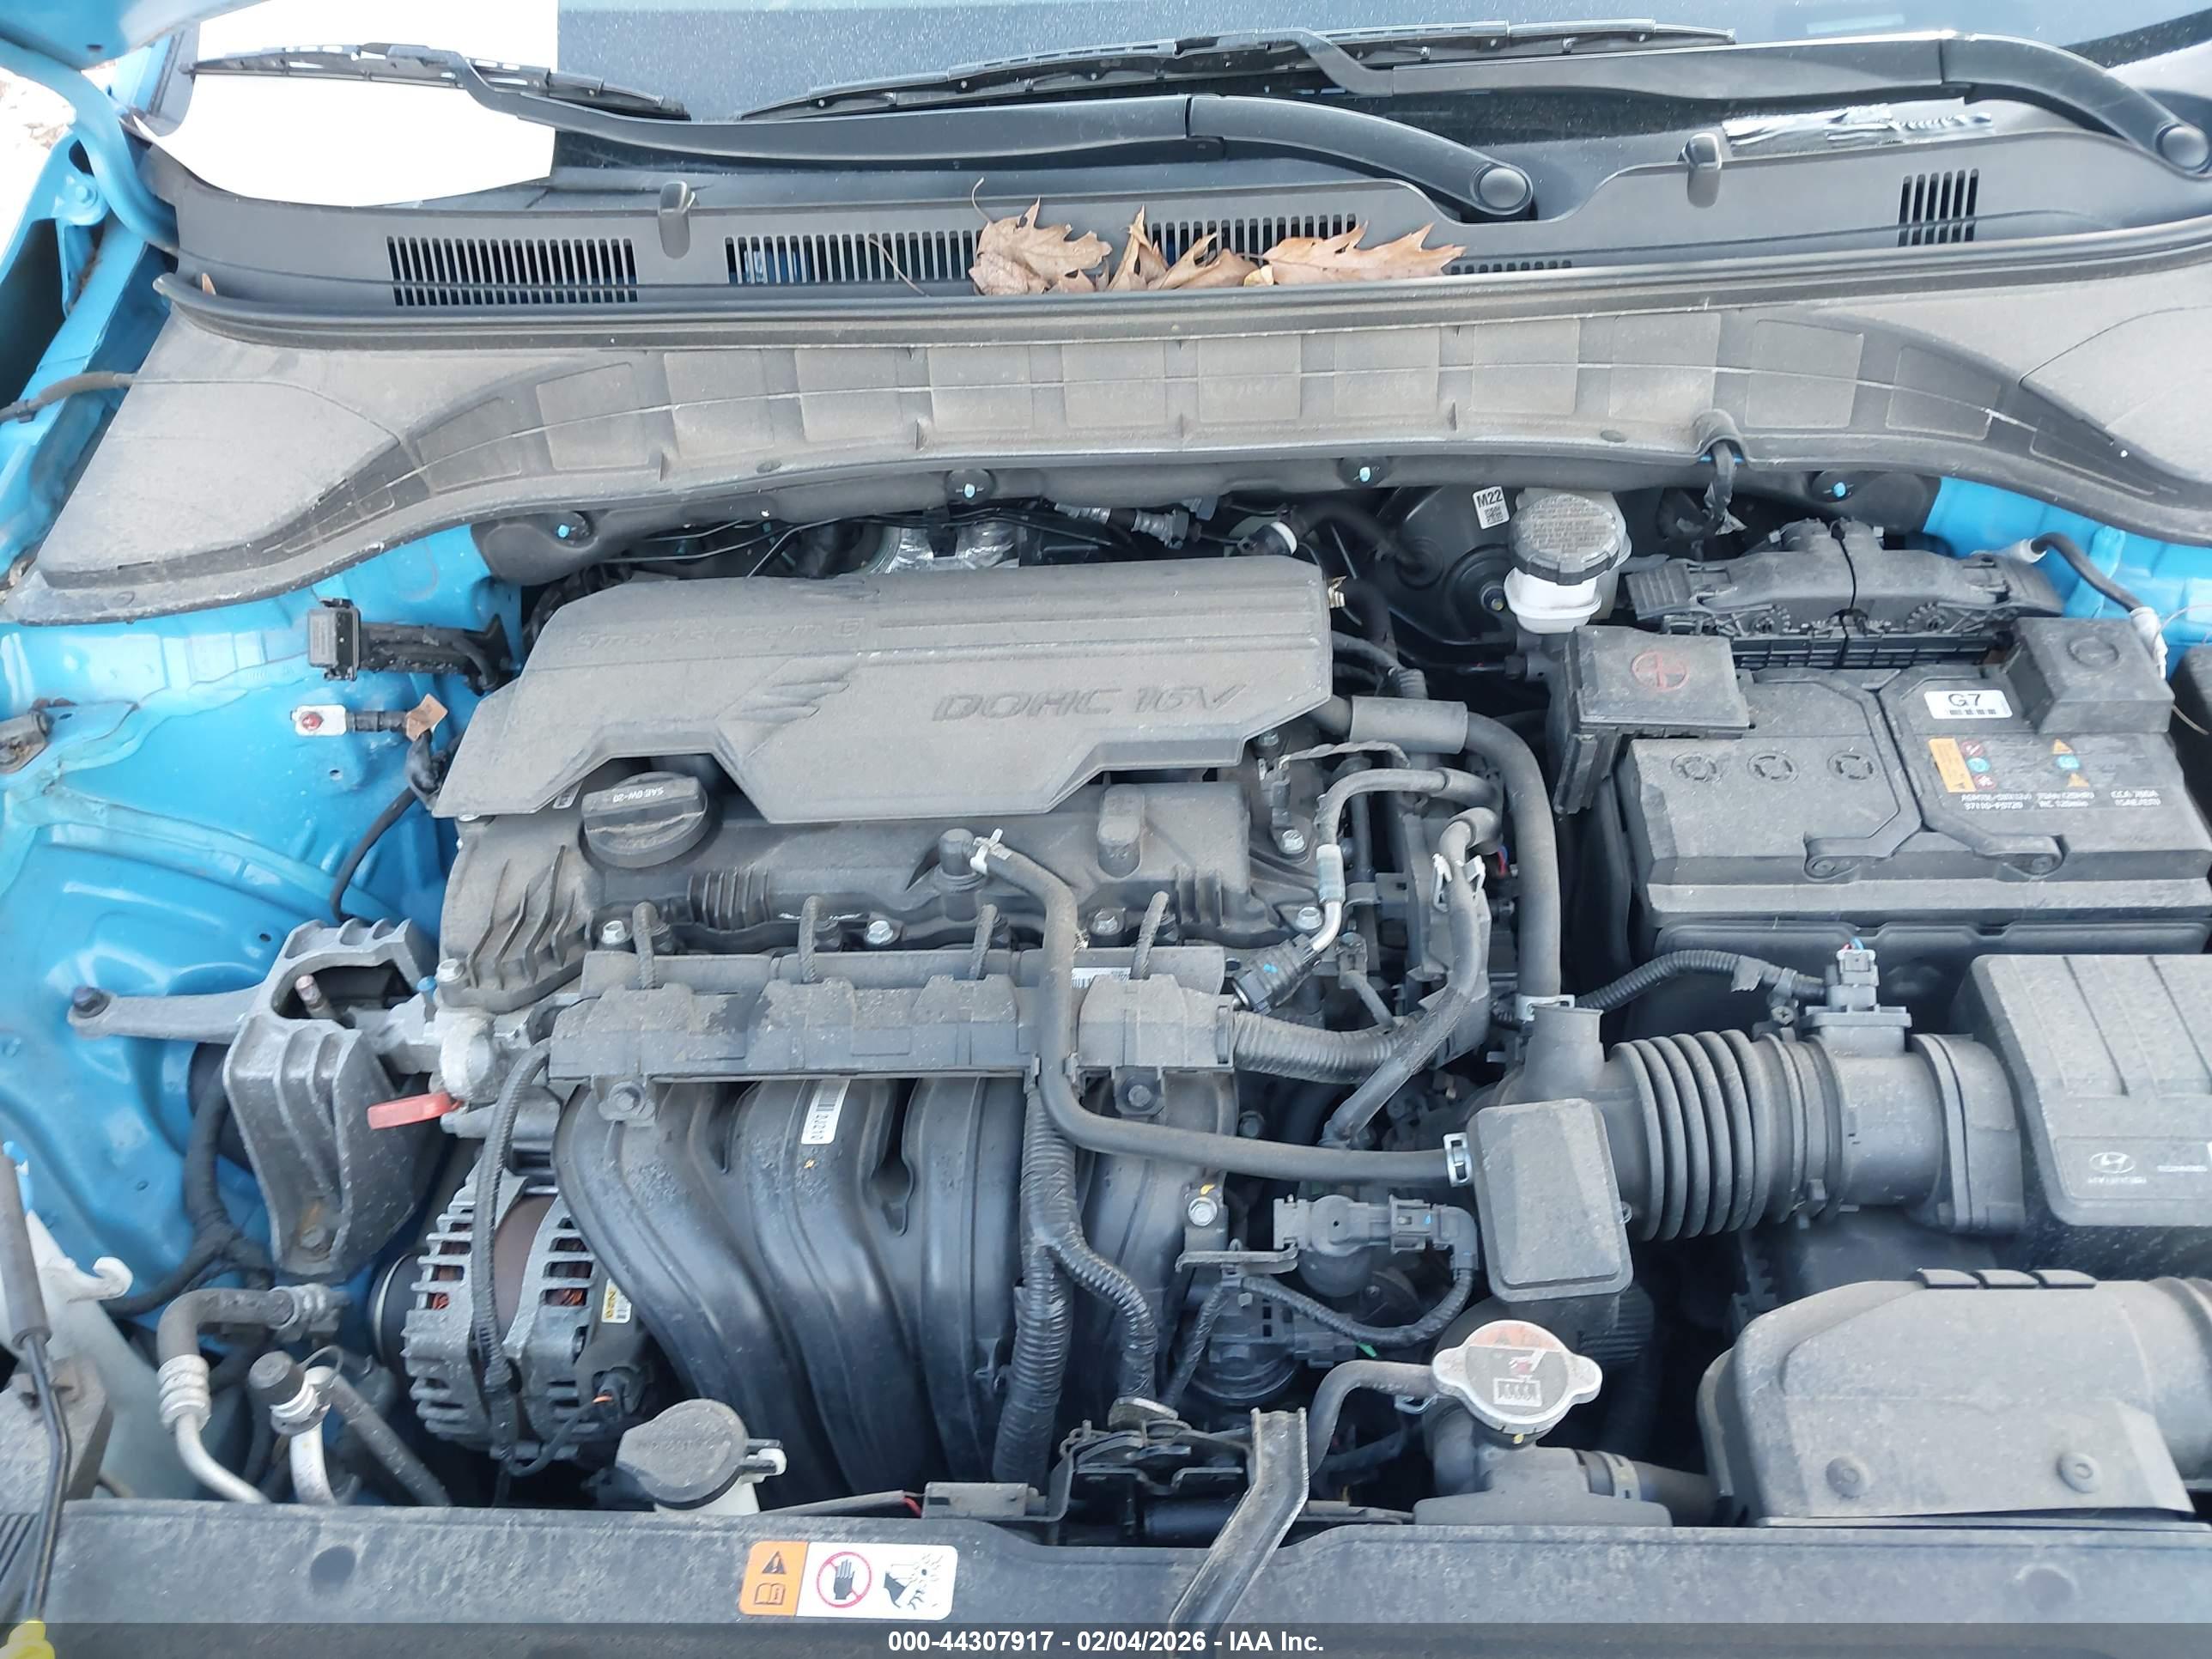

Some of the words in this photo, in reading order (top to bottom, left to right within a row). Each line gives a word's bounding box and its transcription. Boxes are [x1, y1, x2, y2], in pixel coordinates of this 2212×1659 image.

[1476, 489, 1504, 508] M22
[932, 688, 1123, 722] DOHC
[1134, 684, 1248, 714] 16V
[1948, 693, 1983, 708] G7
[612, 787, 644, 803] 0W-20
[644, 786, 665, 799] SAE
